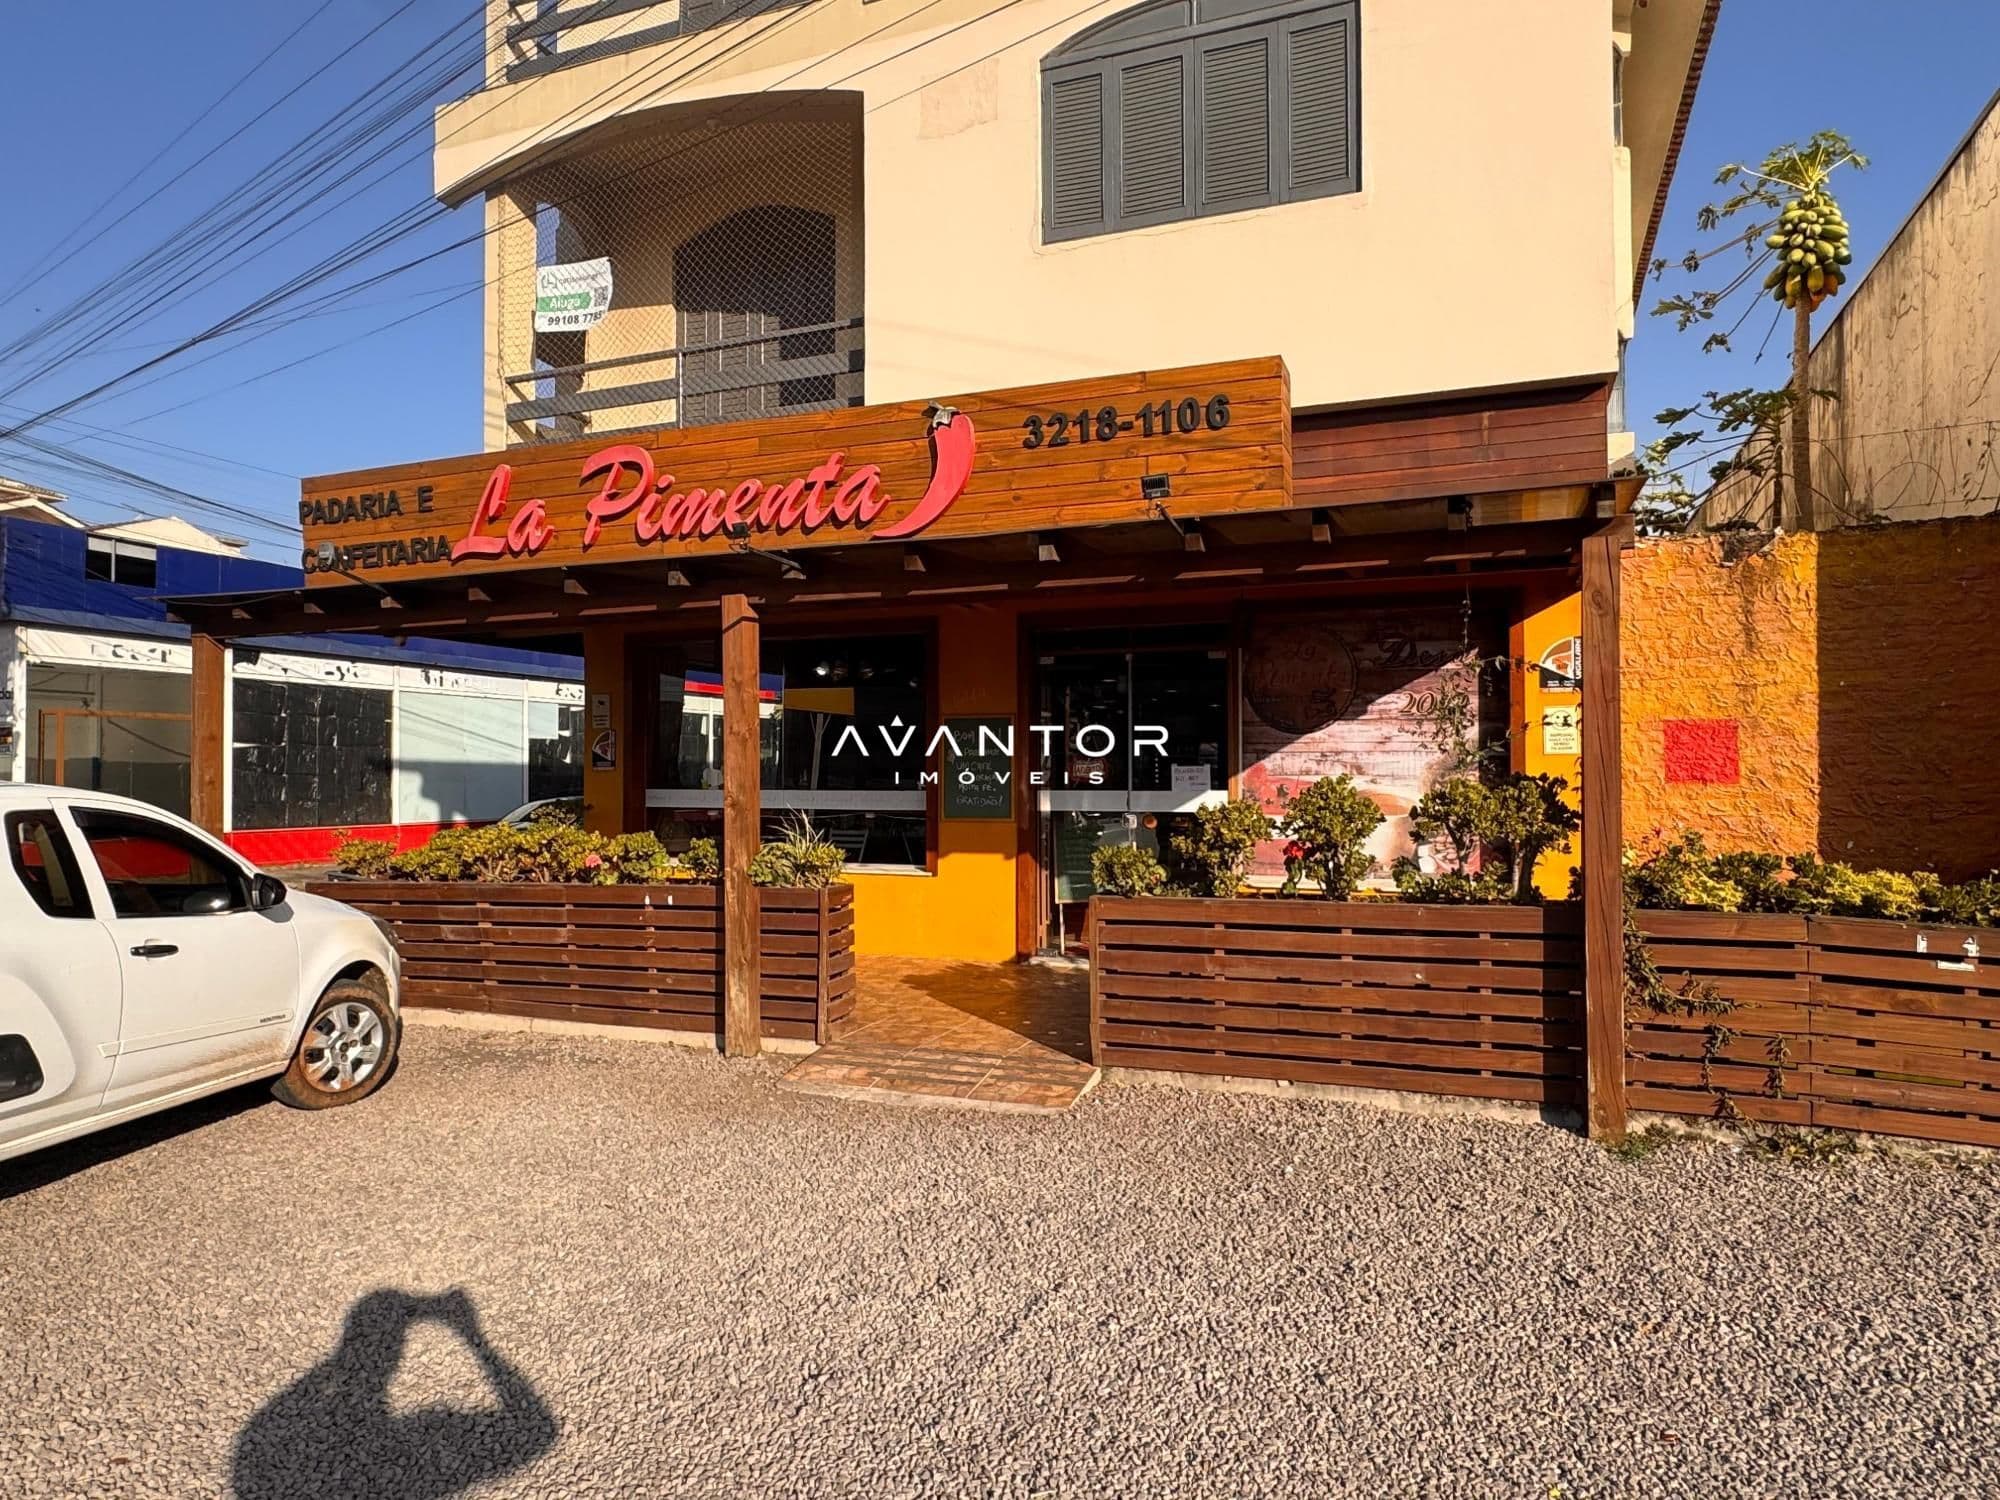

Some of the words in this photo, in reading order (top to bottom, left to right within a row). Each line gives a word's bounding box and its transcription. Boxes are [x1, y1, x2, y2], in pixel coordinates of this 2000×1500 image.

[547, 314, 580, 326] 99108
[549, 298, 581, 310] Aluga
[1022, 394, 1230, 449] 3218-1106
[299, 490, 403, 525] PADARIA
[417, 486, 434, 513] E
[451, 463, 557, 562] La
[579, 445, 891, 552] Pimenta
